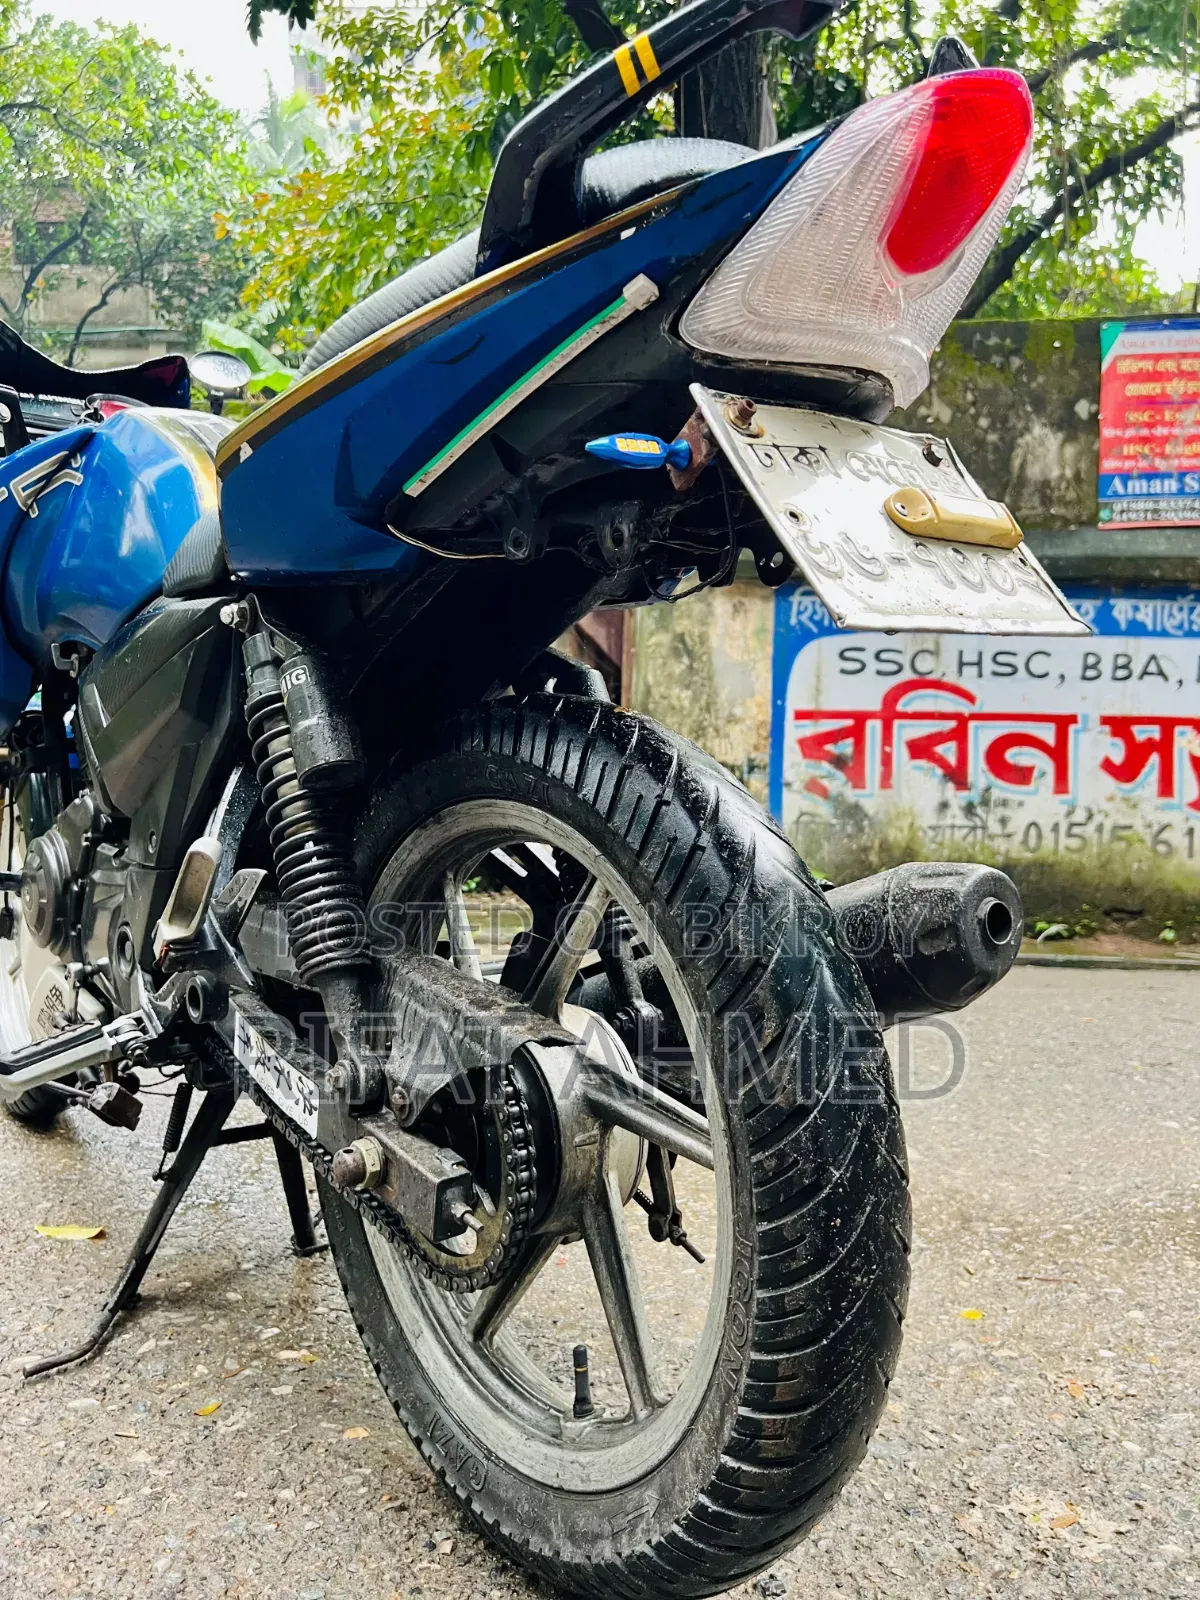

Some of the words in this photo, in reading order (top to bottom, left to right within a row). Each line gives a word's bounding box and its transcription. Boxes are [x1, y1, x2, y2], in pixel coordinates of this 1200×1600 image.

[746, 442, 841, 479] ঢাকা
[1106, 475, 1179, 496] Aman
[794, 678, 1080, 800] রবিন
